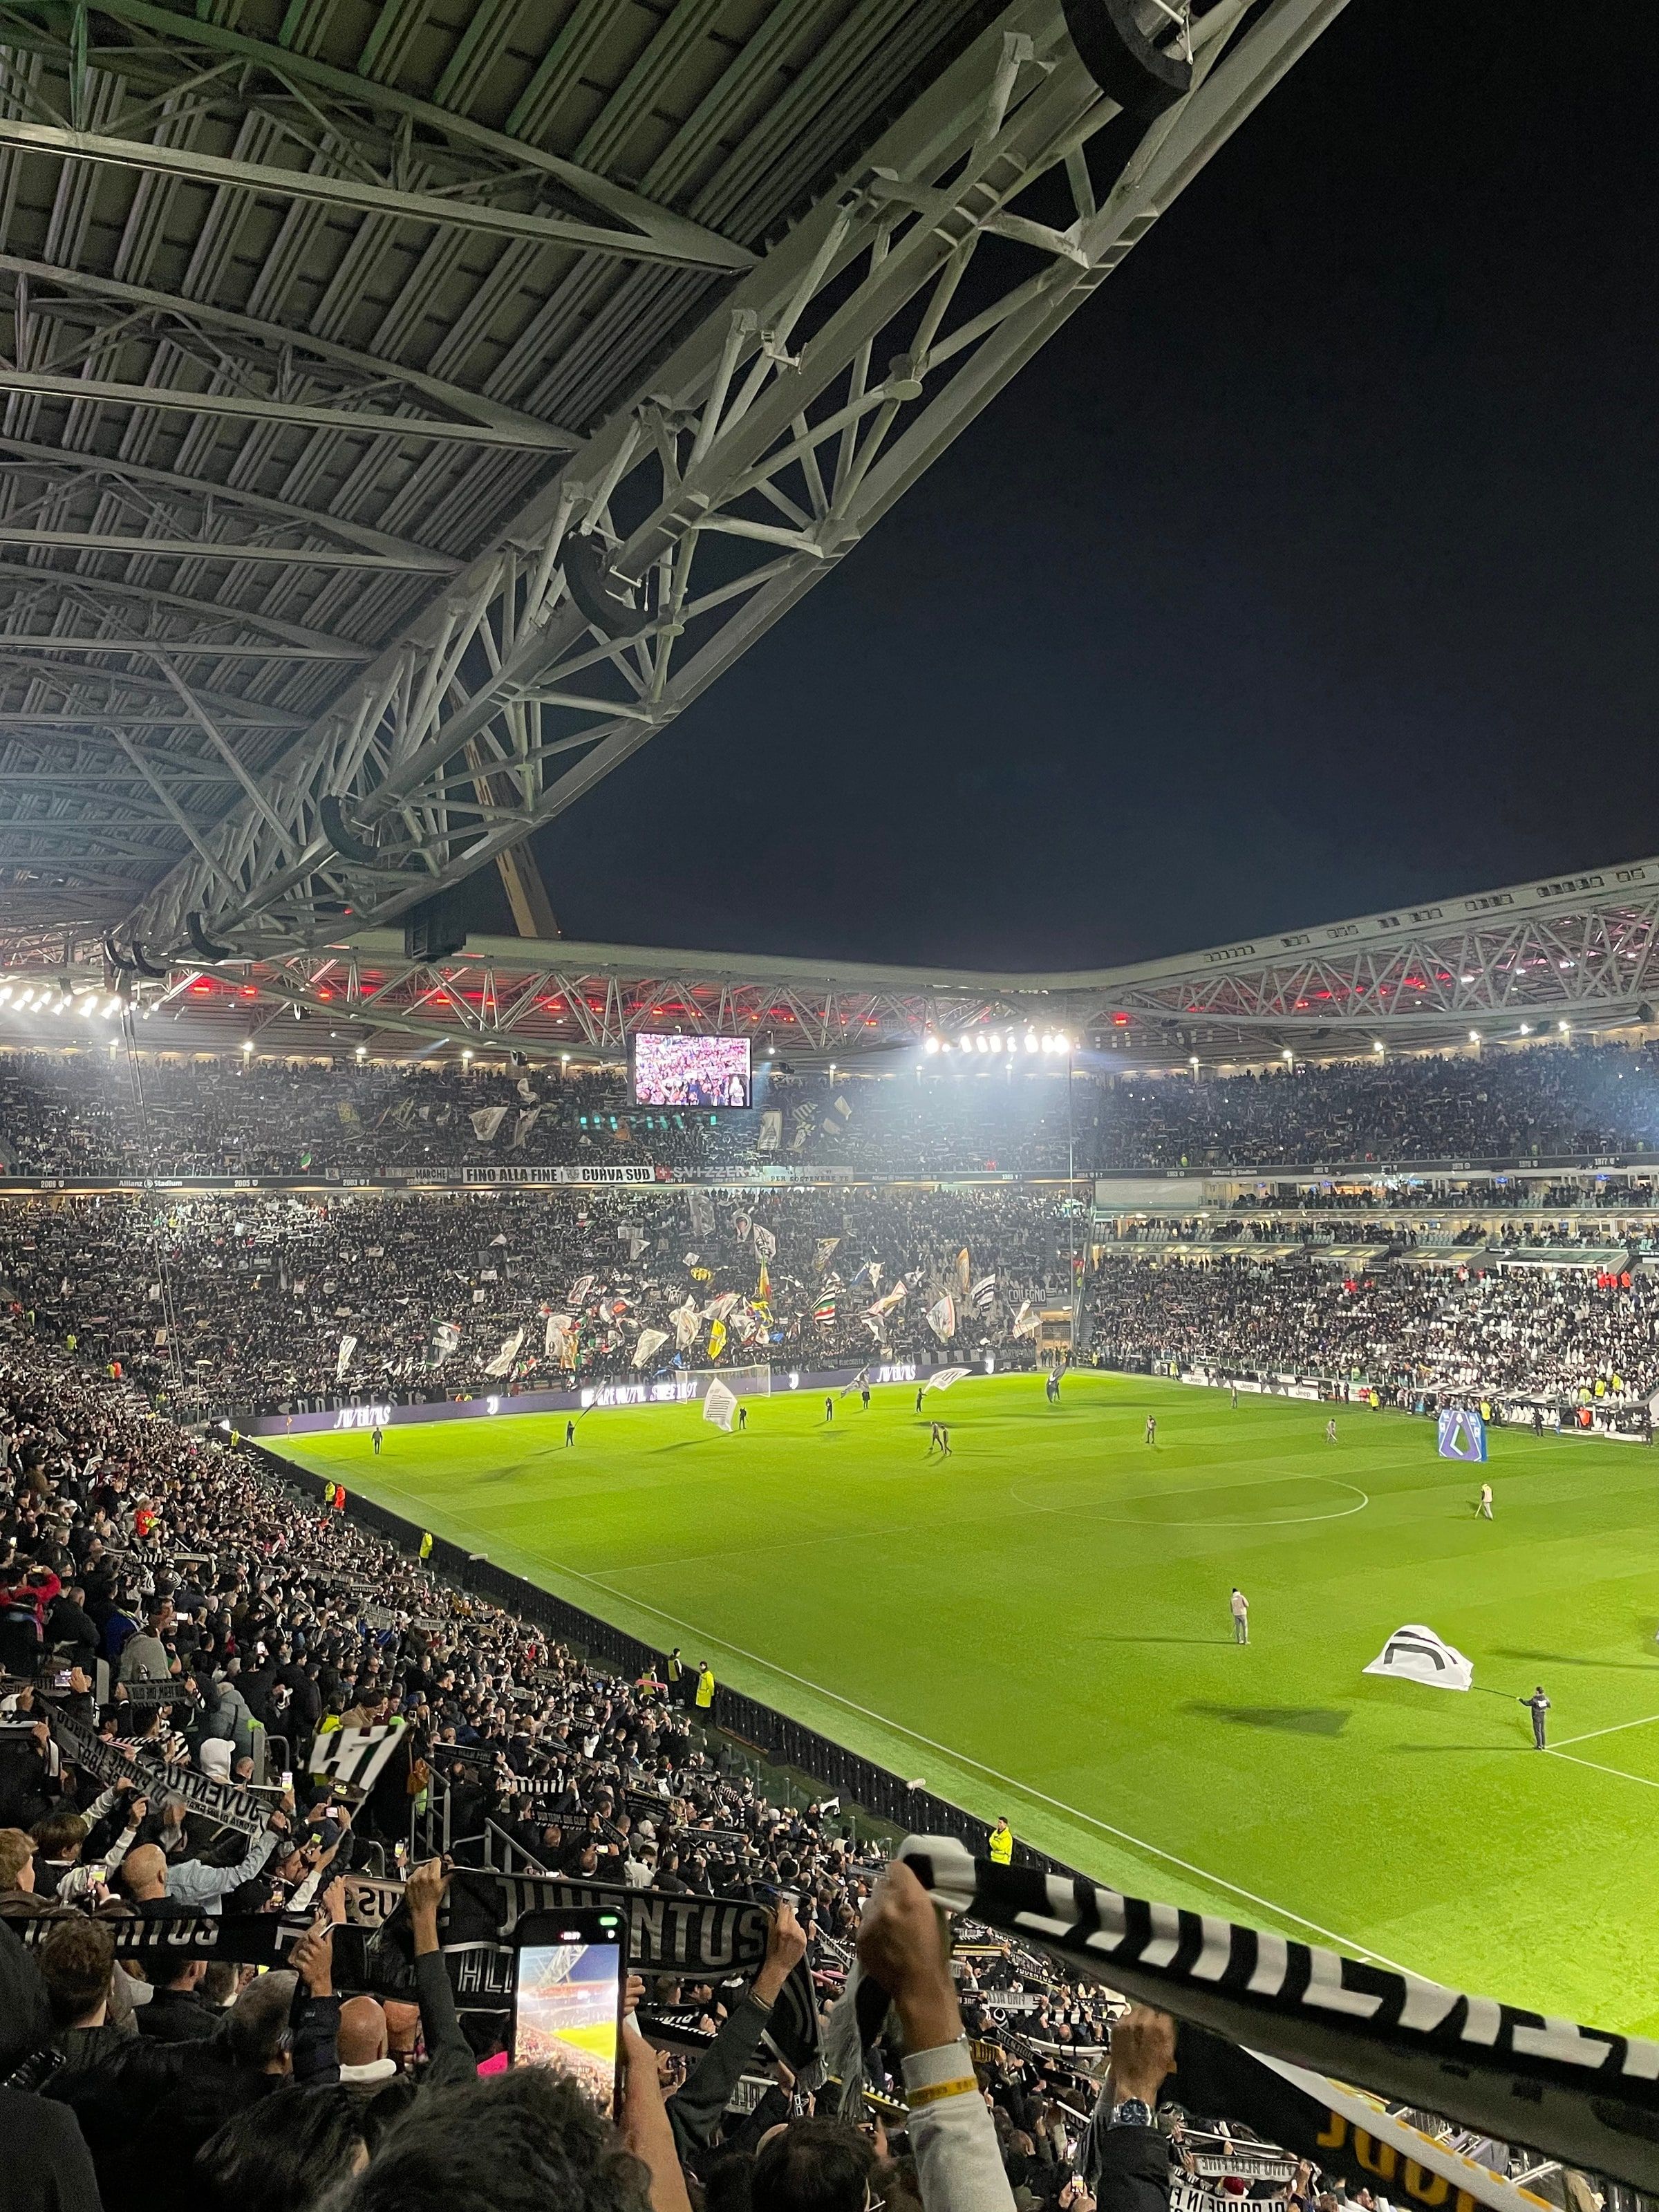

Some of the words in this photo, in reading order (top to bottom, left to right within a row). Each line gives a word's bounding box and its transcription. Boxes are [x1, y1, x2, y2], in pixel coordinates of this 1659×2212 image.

[415, 1169, 446, 1179] MARCHE
[467, 1168, 495, 1181] FINO
[498, 1168, 526, 1181] ALLA
[531, 1169, 557, 1181] FINE
[583, 1168, 622, 1181] CURVA
[626, 1168, 650, 1180] SUD
[673, 1166, 758, 1178] SVIZZERA
[1009, 1289, 1045, 1302] COLLEGNO
[1239, 1382, 1254, 1391] Jeep
[1296, 1389, 1311, 1398] Jeep
[333, 1405, 390, 1429] JUVENTUS
